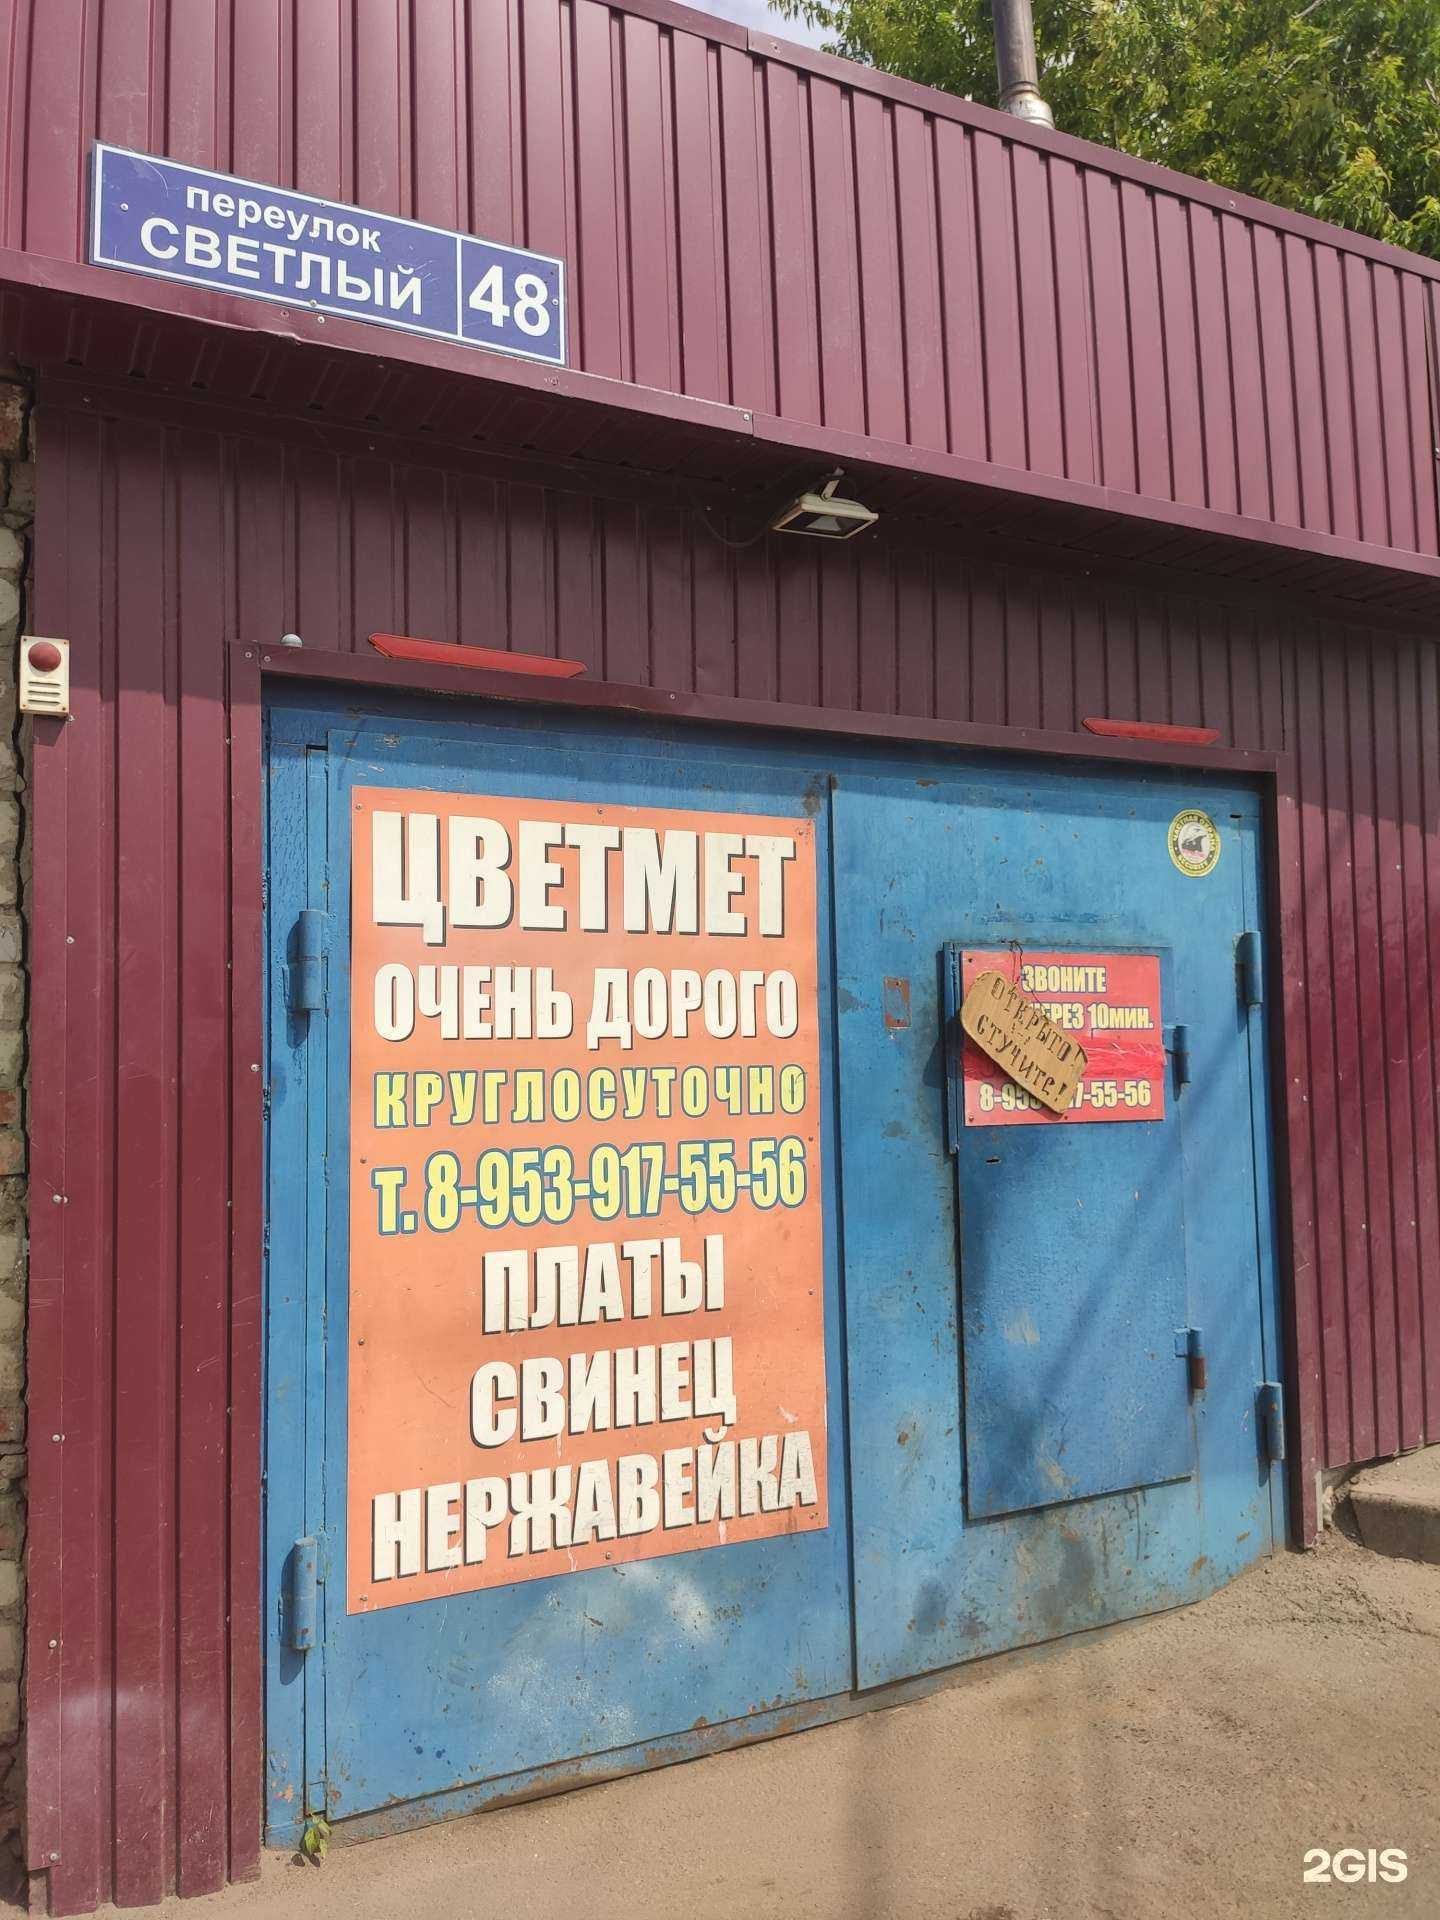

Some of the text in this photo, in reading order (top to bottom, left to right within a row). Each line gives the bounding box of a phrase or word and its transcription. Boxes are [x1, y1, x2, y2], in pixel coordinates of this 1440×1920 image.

[139, 217, 424, 316] СВЕТЛЫЙ
[185, 184, 382, 253] переулок
[468, 264, 551, 338] 48
[372, 810, 796, 947] ЦВЕТМЕТ
[374, 963, 800, 1050] ОЧЕНЬ ДОРОГО
[1021, 965, 1107, 993] ЗВОНИТЕ
[373, 1064, 808, 1128] КРУГЛОСУТОЧНО
[371, 1135, 808, 1236] Т. 8-953-917-55-56
[482, 1234, 725, 1335] ПЛАТЫ
[470, 1337, 737, 1449] СВИНЕЦ
[371, 1425, 819, 1584] НЕРЖАВЕЙКА
